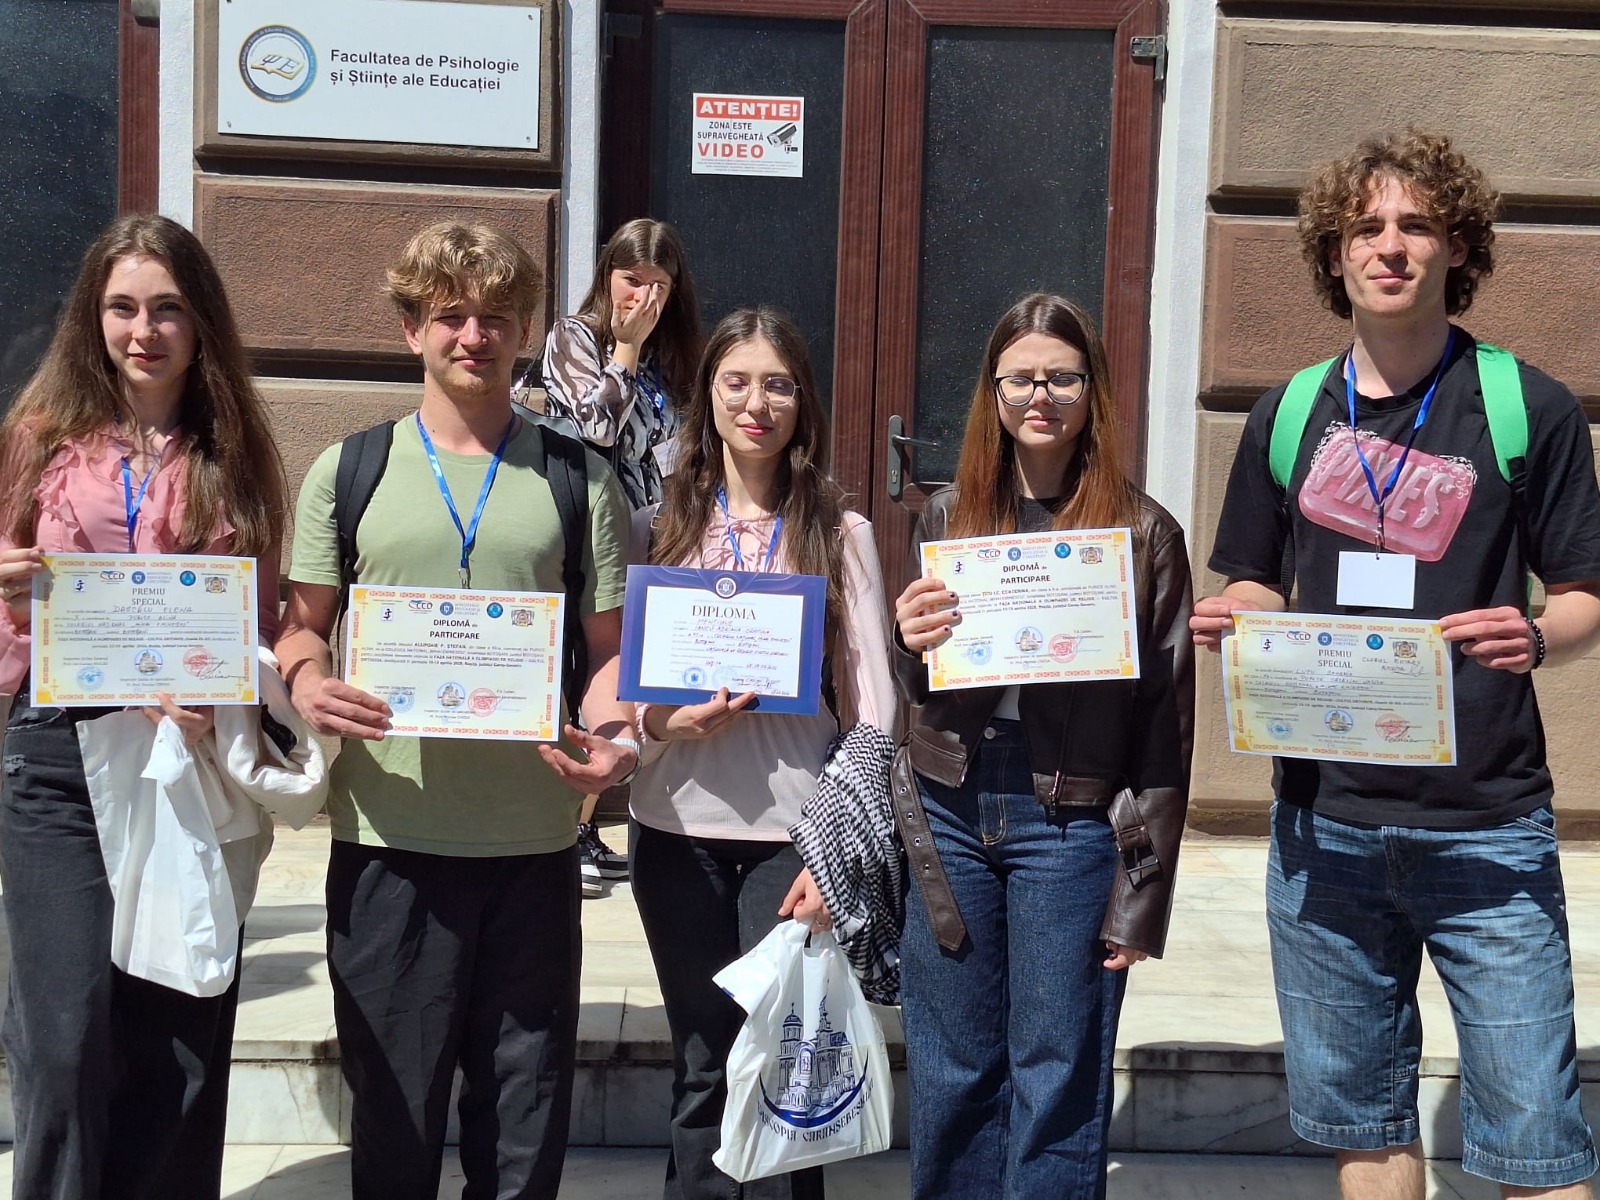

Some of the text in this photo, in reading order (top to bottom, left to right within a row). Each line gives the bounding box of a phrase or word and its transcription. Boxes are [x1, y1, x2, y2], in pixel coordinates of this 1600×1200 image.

[330, 49, 520, 74] Facultatea de Psihologie
[330, 70, 501, 93] și Științe ale Educației
[700, 100, 798, 120] ATENȚIE!
[709, 121, 752, 130] ZONA ESTE
[697, 143, 764, 159] VIDEO
[1003, 562, 1040, 573] DIPLOMĂ
[1001, 575, 1050, 585] PARTICIPARE
[132, 587, 166, 596] PREMIU
[131, 597, 166, 606] SPECIAL
[692, 605, 756, 620] DIPLOMA
[433, 618, 470, 628] DIPLOMĂ
[429, 631, 480, 640] PARTICIPARE
[1318, 649, 1352, 658] PREMIU
[1317, 659, 1353, 669] SPECIAL
